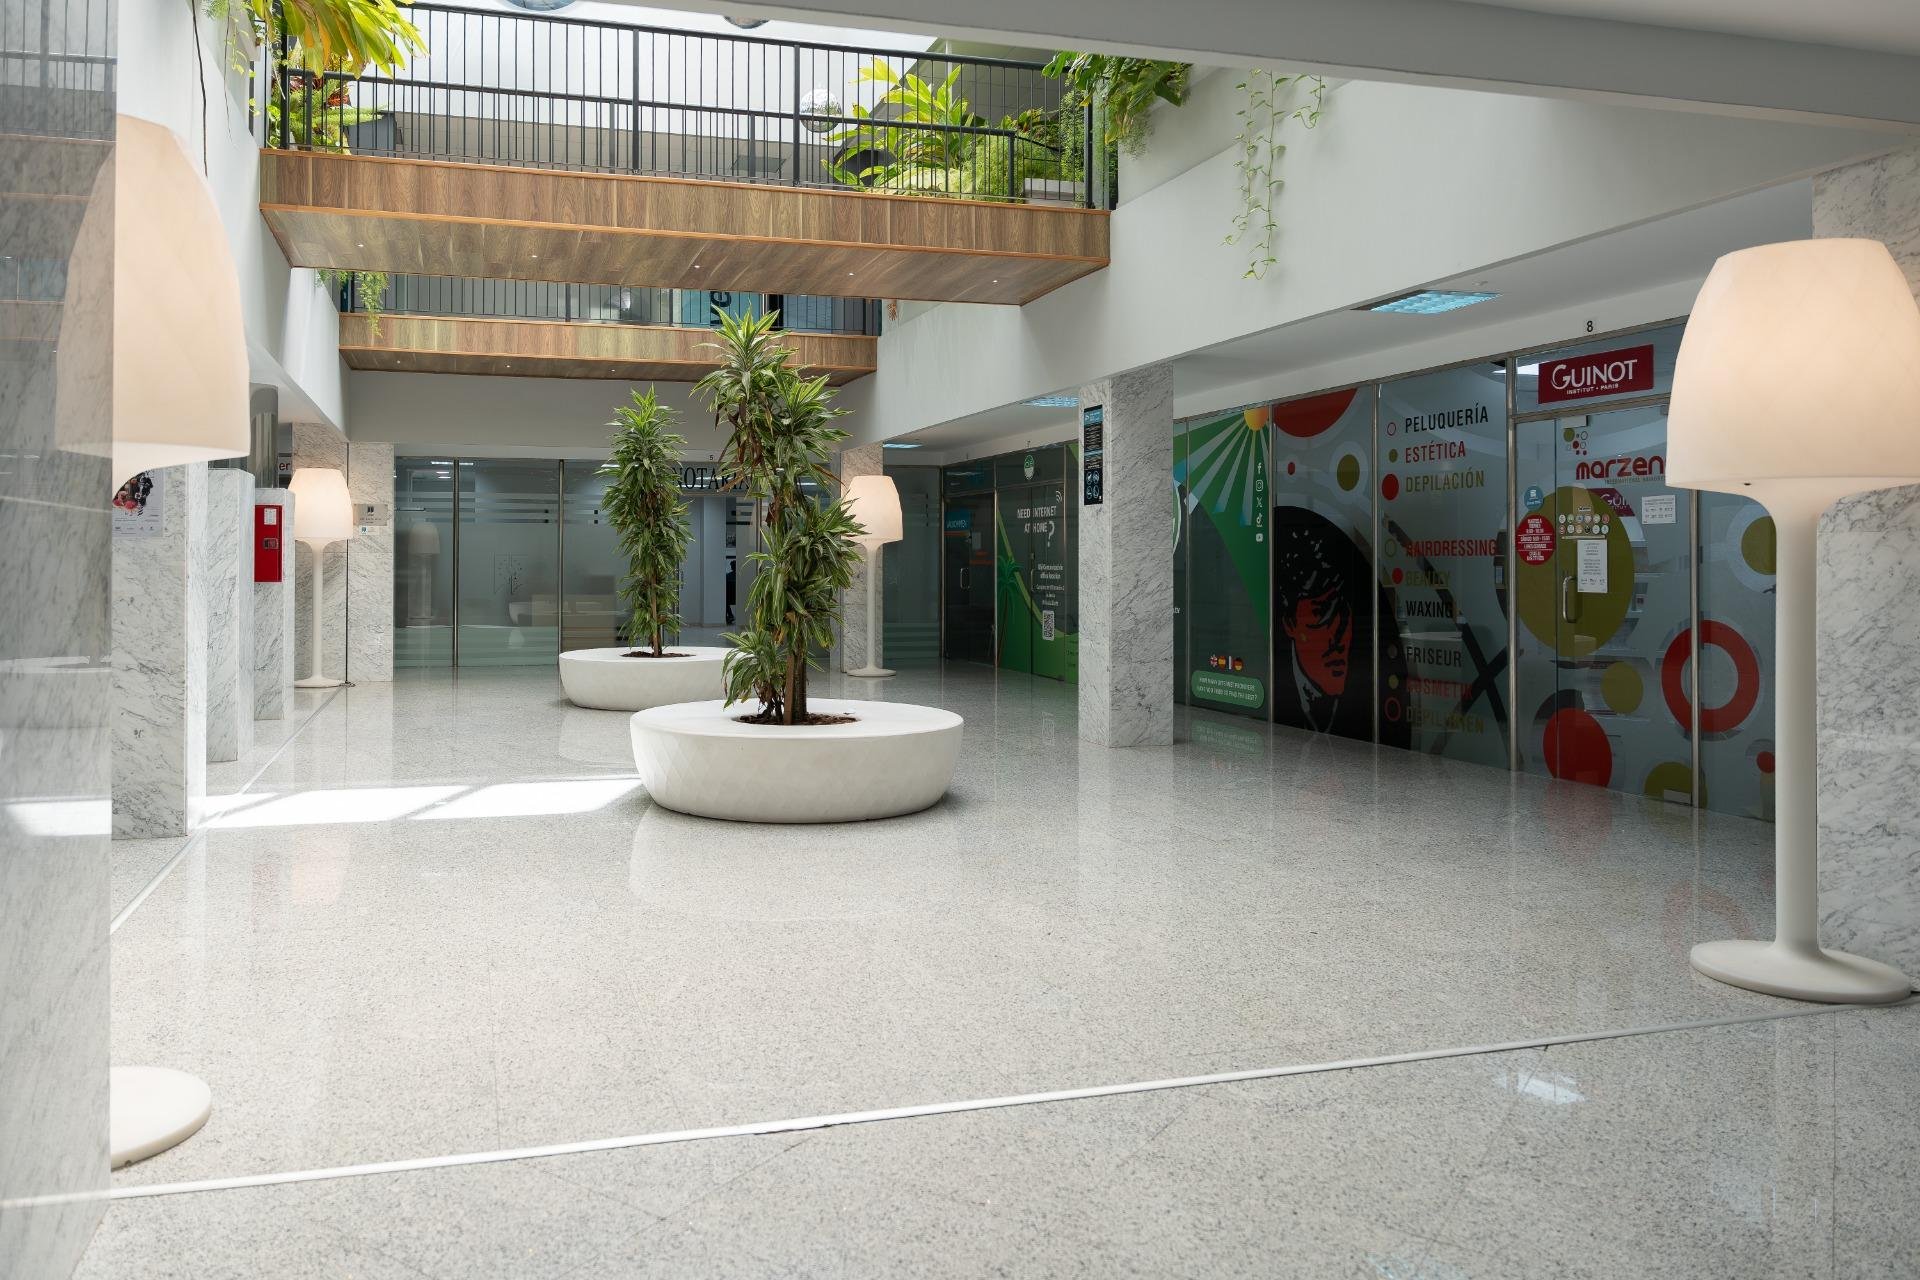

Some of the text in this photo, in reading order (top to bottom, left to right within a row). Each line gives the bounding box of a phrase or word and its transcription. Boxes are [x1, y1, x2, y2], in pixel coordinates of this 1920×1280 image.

[1586, 320, 1594, 332] 8
[1551, 359, 1638, 390] GUINOT
[1566, 386, 1595, 395] INSTITUT
[1405, 403, 1489, 433] PELUQUERÍA
[1405, 441, 1466, 463] ESTÉTICA
[1576, 455, 1666, 480] marzen
[1405, 467, 1485, 492] DEPILACIÓN
[1406, 539, 1498, 557] HAIRDRESSING
[1406, 600, 1454, 618] WAXING
[1406, 646, 1462, 667] FRISEUR
